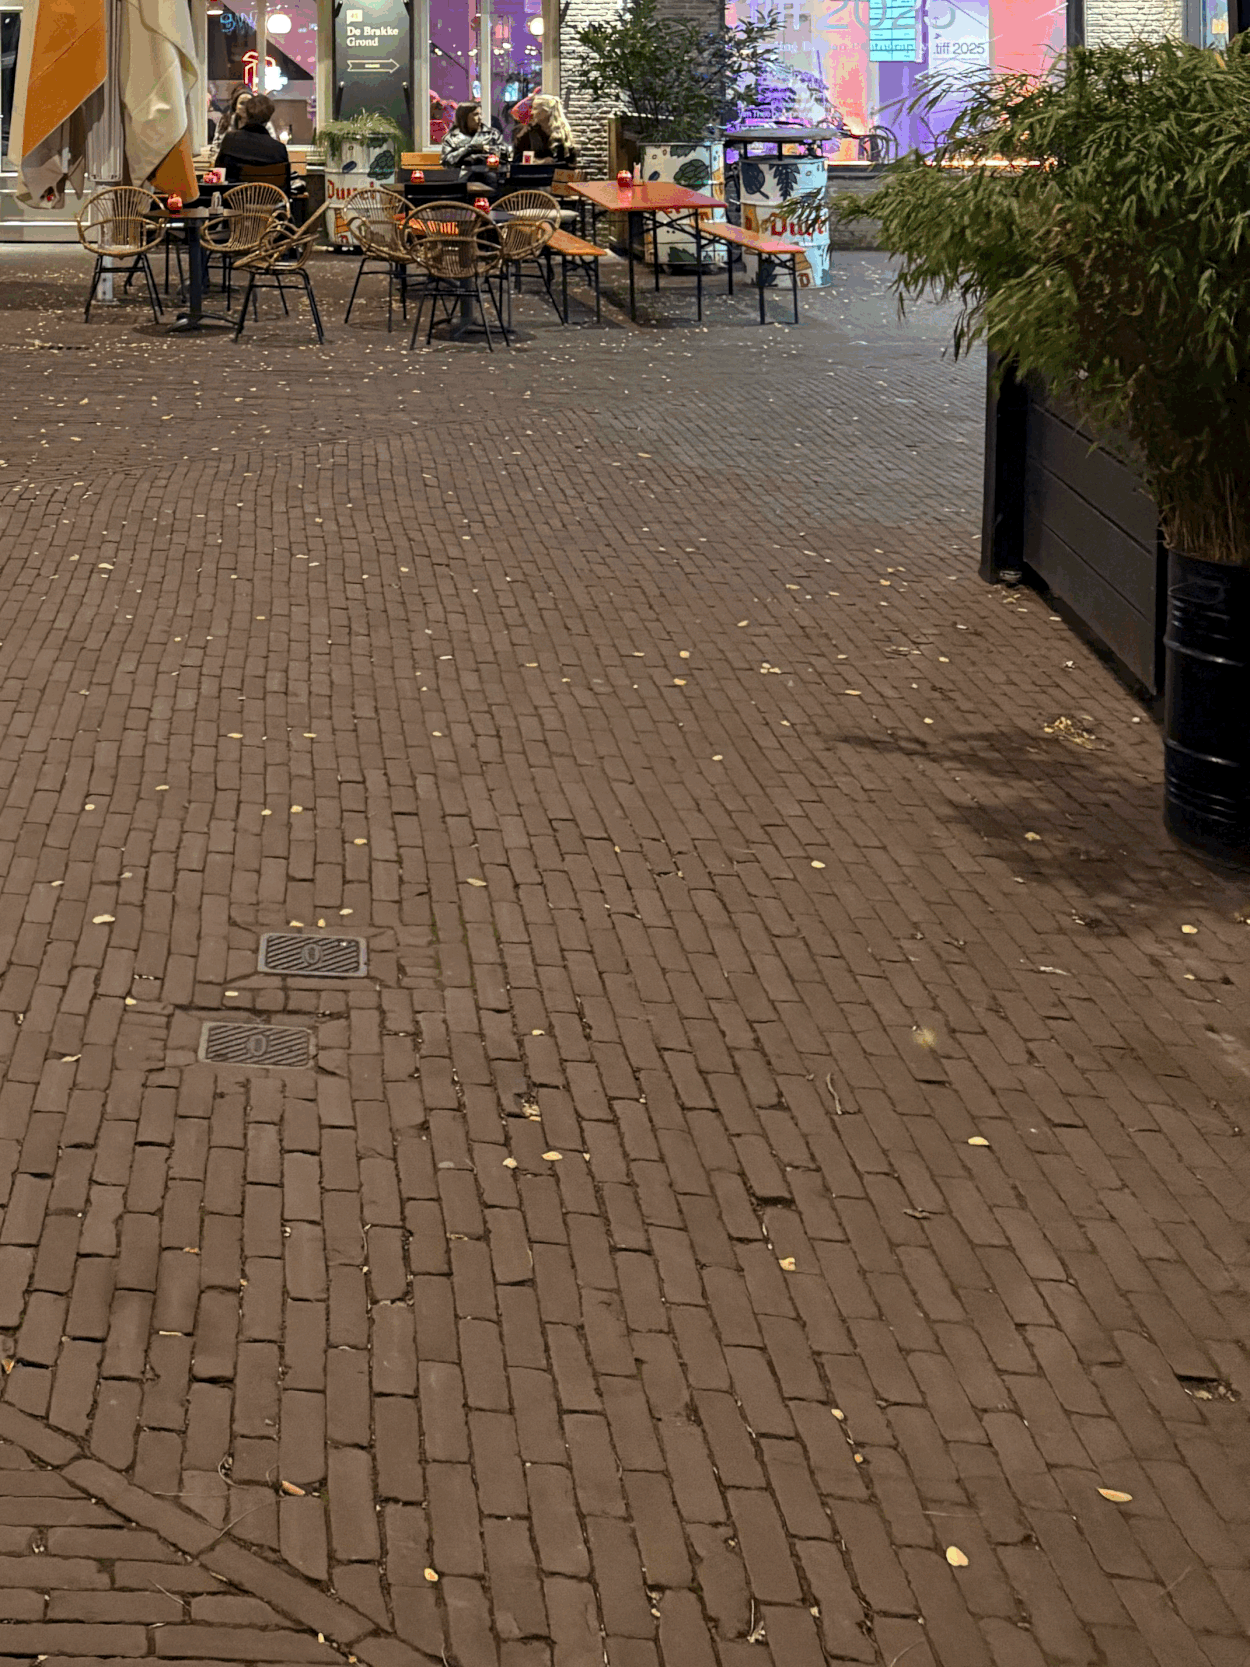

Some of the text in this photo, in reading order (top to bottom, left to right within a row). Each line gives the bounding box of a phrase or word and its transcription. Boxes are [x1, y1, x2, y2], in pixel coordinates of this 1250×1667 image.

[346, 25, 399, 36] De Brakke
[346, 37, 379, 47] Grond
[953, 42, 985, 55] 2025
